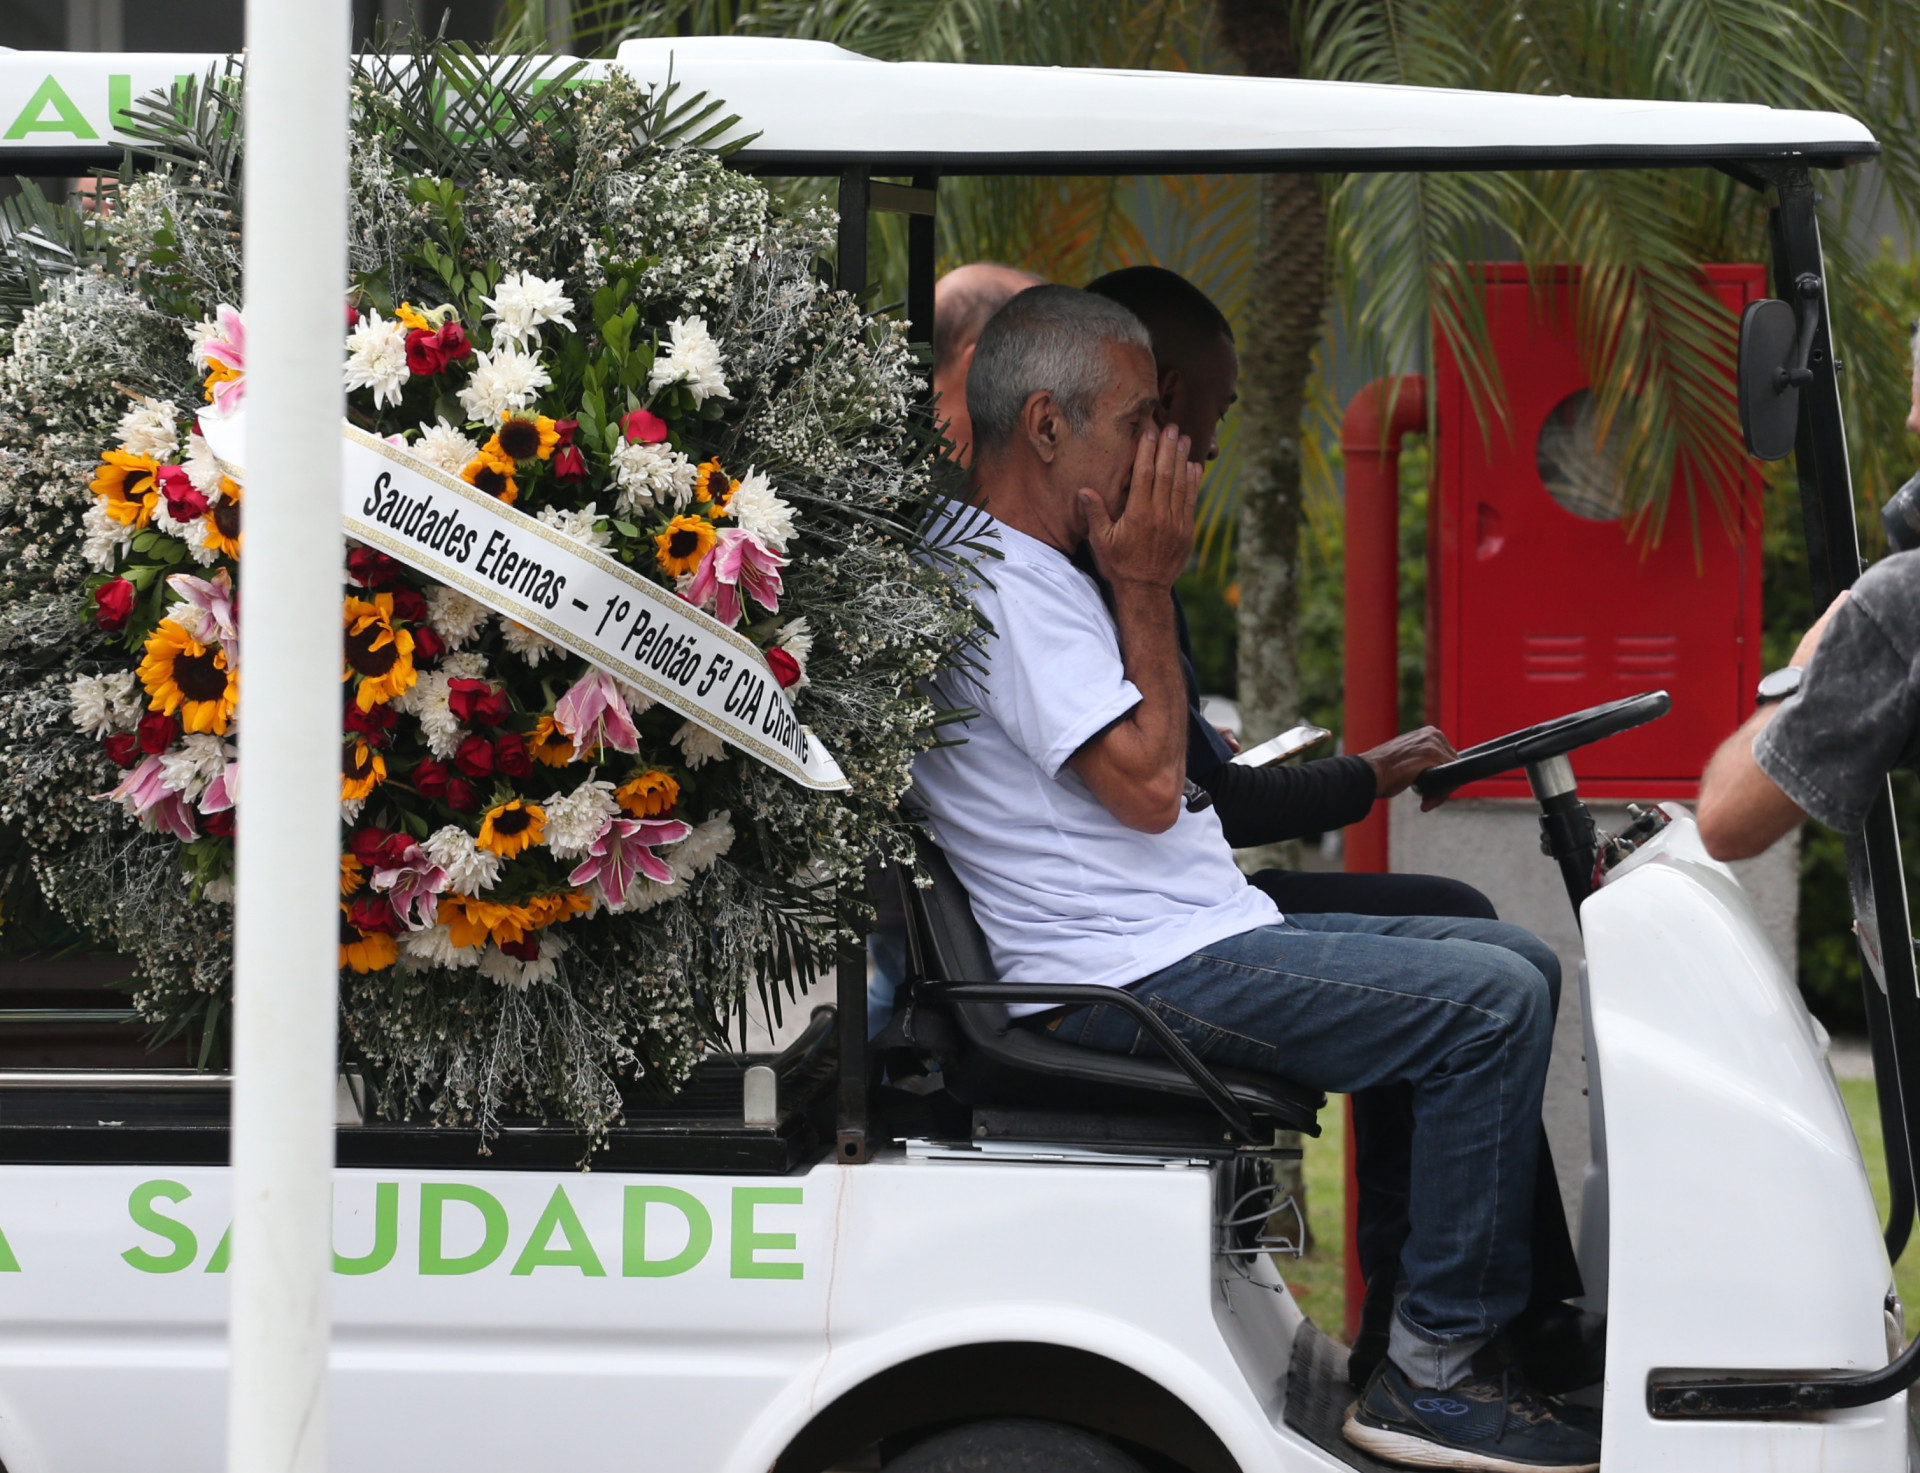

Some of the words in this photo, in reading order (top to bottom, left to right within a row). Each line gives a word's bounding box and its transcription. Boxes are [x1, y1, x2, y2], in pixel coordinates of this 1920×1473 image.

[363, 471, 478, 564] Saudades
[475, 529, 567, 610] Eternas
[620, 608, 702, 687] Pelotão
[723, 668, 765, 726] CIA
